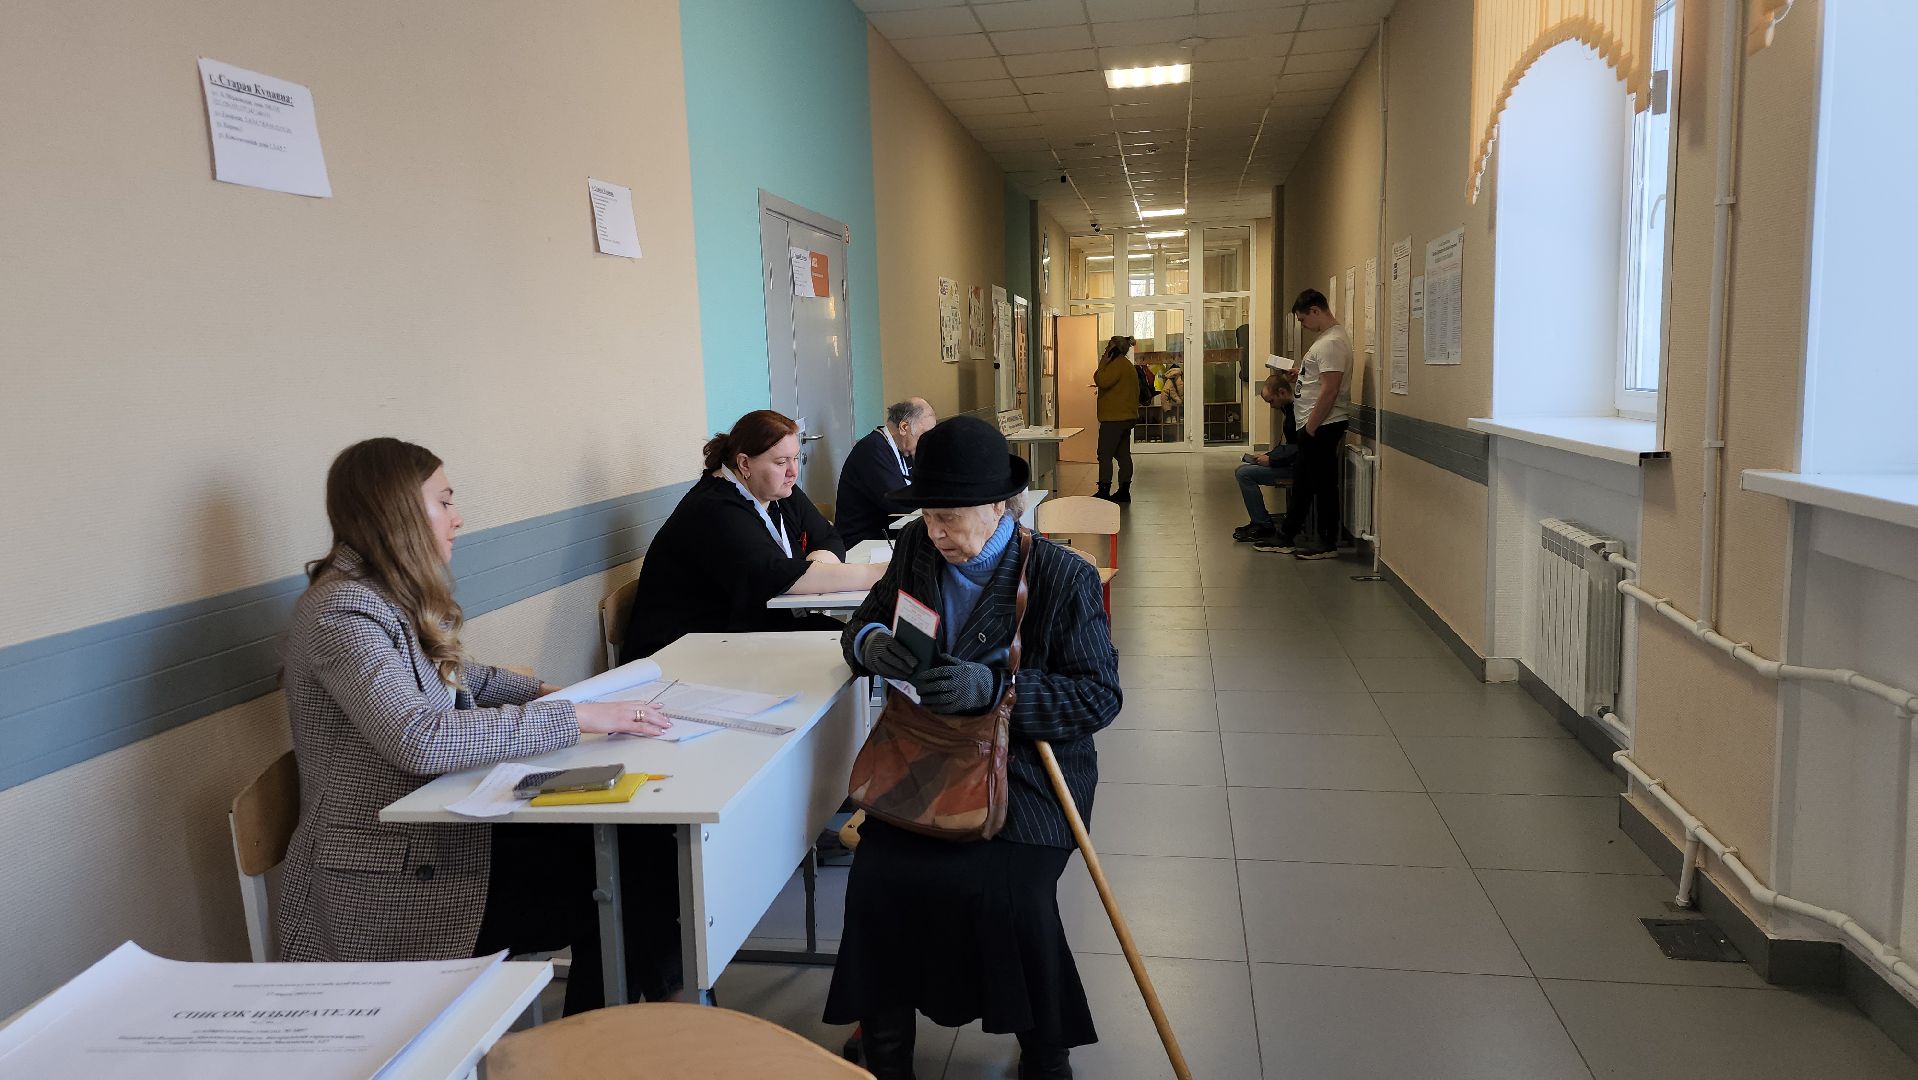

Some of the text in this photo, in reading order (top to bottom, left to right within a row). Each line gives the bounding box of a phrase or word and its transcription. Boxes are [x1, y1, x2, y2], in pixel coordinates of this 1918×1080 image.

[219, 73, 252, 92] Старая
[254, 83, 293, 104] Купавна:
[173, 1007, 382, 1019] СПИСОК ИЗБИРАТЕЛЕЙ
